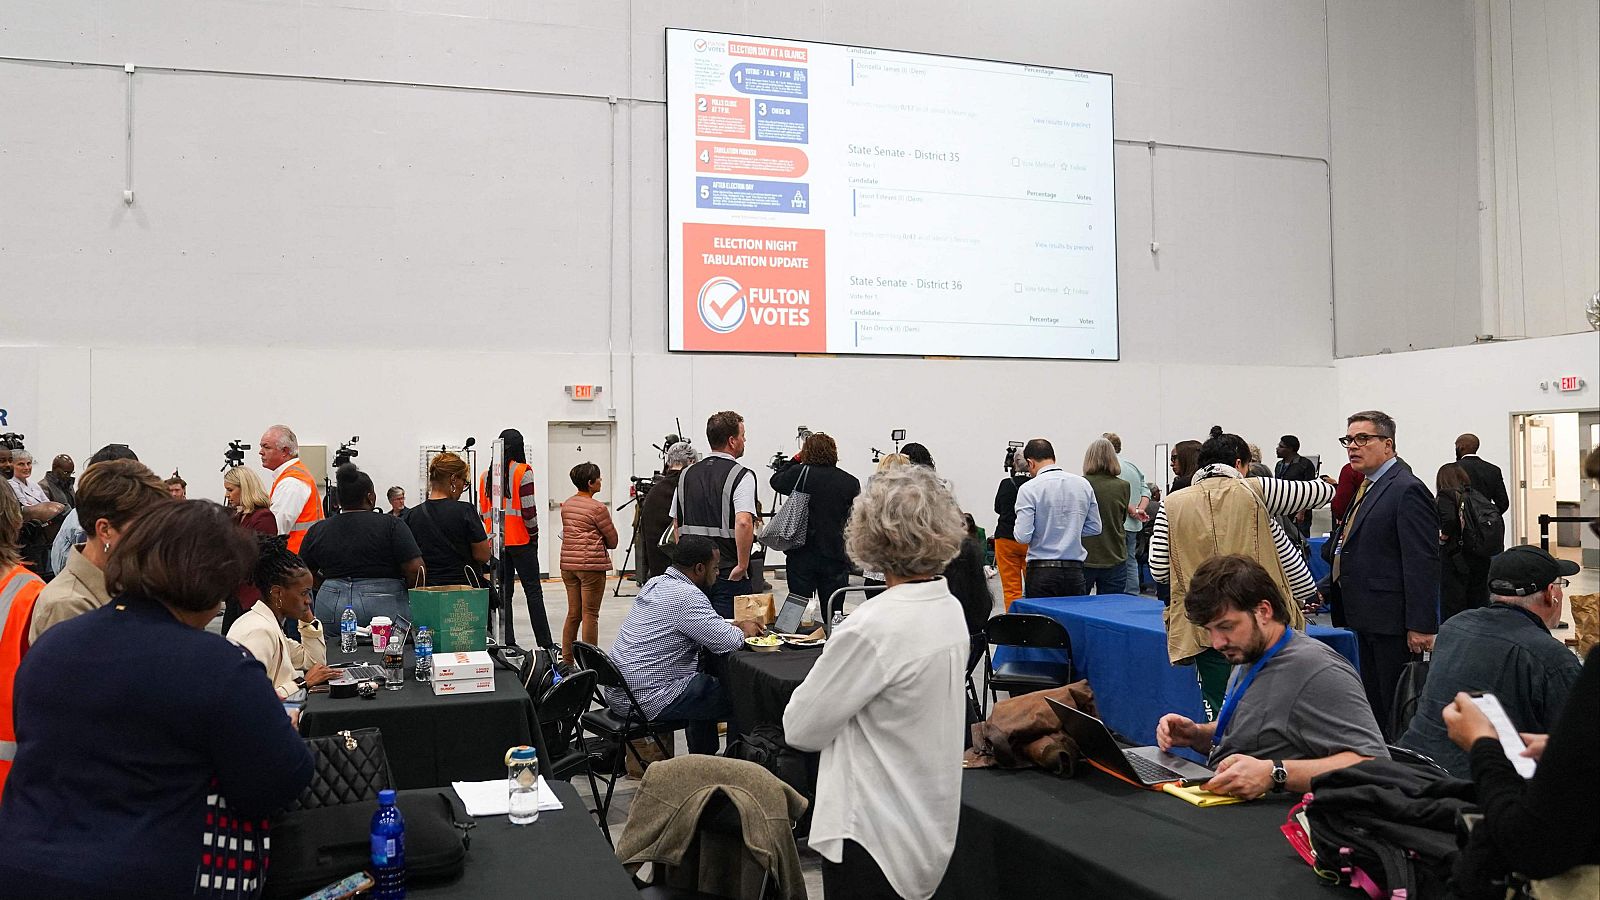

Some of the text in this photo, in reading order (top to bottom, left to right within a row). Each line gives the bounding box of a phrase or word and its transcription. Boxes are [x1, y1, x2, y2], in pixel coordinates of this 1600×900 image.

[730, 44, 757, 55] ELECTION
[757, 47, 770, 56] DAY
[770, 48, 779, 57] AT
[784, 50, 806, 60] GLANCE
[735, 71, 741, 83] 1
[1024, 66, 1054, 76] Percentage
[698, 98, 707, 112] 2
[759, 103, 767, 116] 3
[700, 150, 710, 163] 4
[848, 144, 871, 155] State
[874, 146, 905, 157] Senate
[914, 150, 946, 160] District
[950, 152, 960, 162] 35
[701, 185, 709, 199] 5
[1027, 190, 1056, 199] Percentage
[714, 237, 797, 251] ELECTION NIGHT
[702, 254, 808, 268] TABULATION UPDATE
[850, 276, 874, 286] State
[876, 276, 908, 288] Senate
[917, 278, 949, 290] District
[952, 280, 963, 290] 36
[749, 288, 810, 304] FULTON
[750, 307, 810, 326] VOTES
[1030, 315, 1059, 324] Percentage
[1562, 377, 1577, 389] EXIT
[576, 386, 592, 397] EXIT
